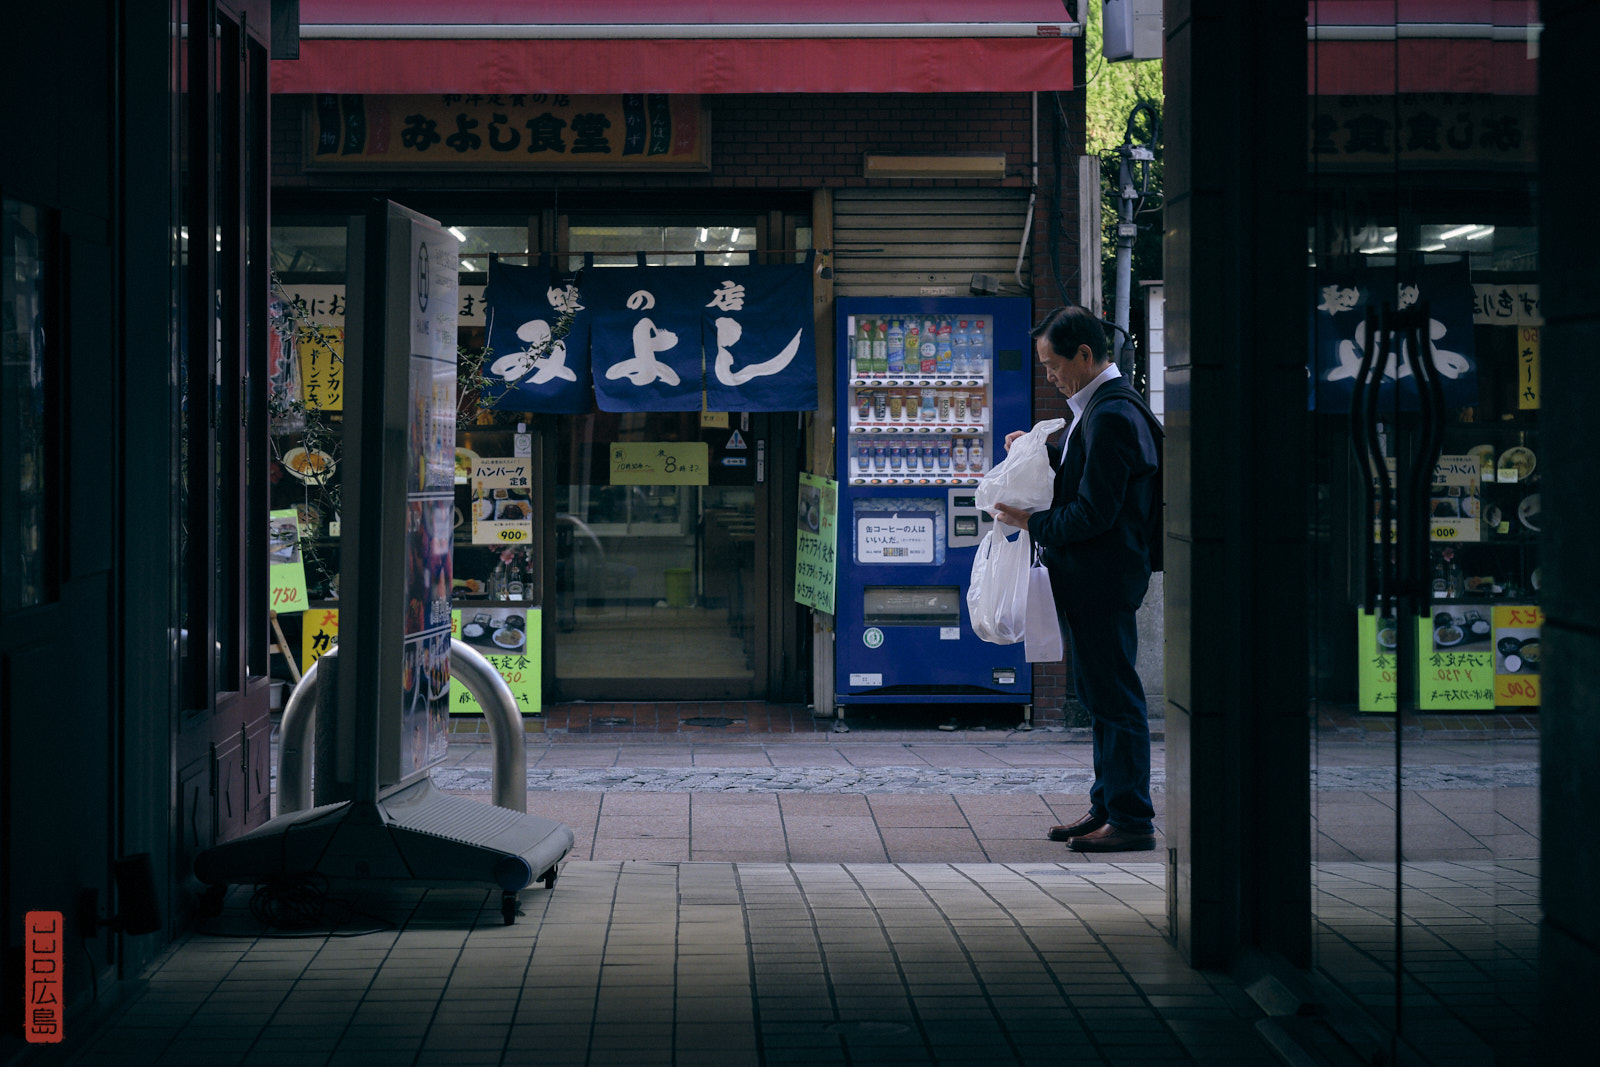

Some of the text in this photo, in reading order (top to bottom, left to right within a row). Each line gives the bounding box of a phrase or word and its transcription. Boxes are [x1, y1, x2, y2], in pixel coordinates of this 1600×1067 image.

[402, 113, 611, 153] みよし食堂
[490, 316, 803, 387] みよし
[476, 466, 525, 477] ハンバーグ
[509, 476, 527, 486] 定食
[866, 525, 925, 533] 缶コーヒーの人は
